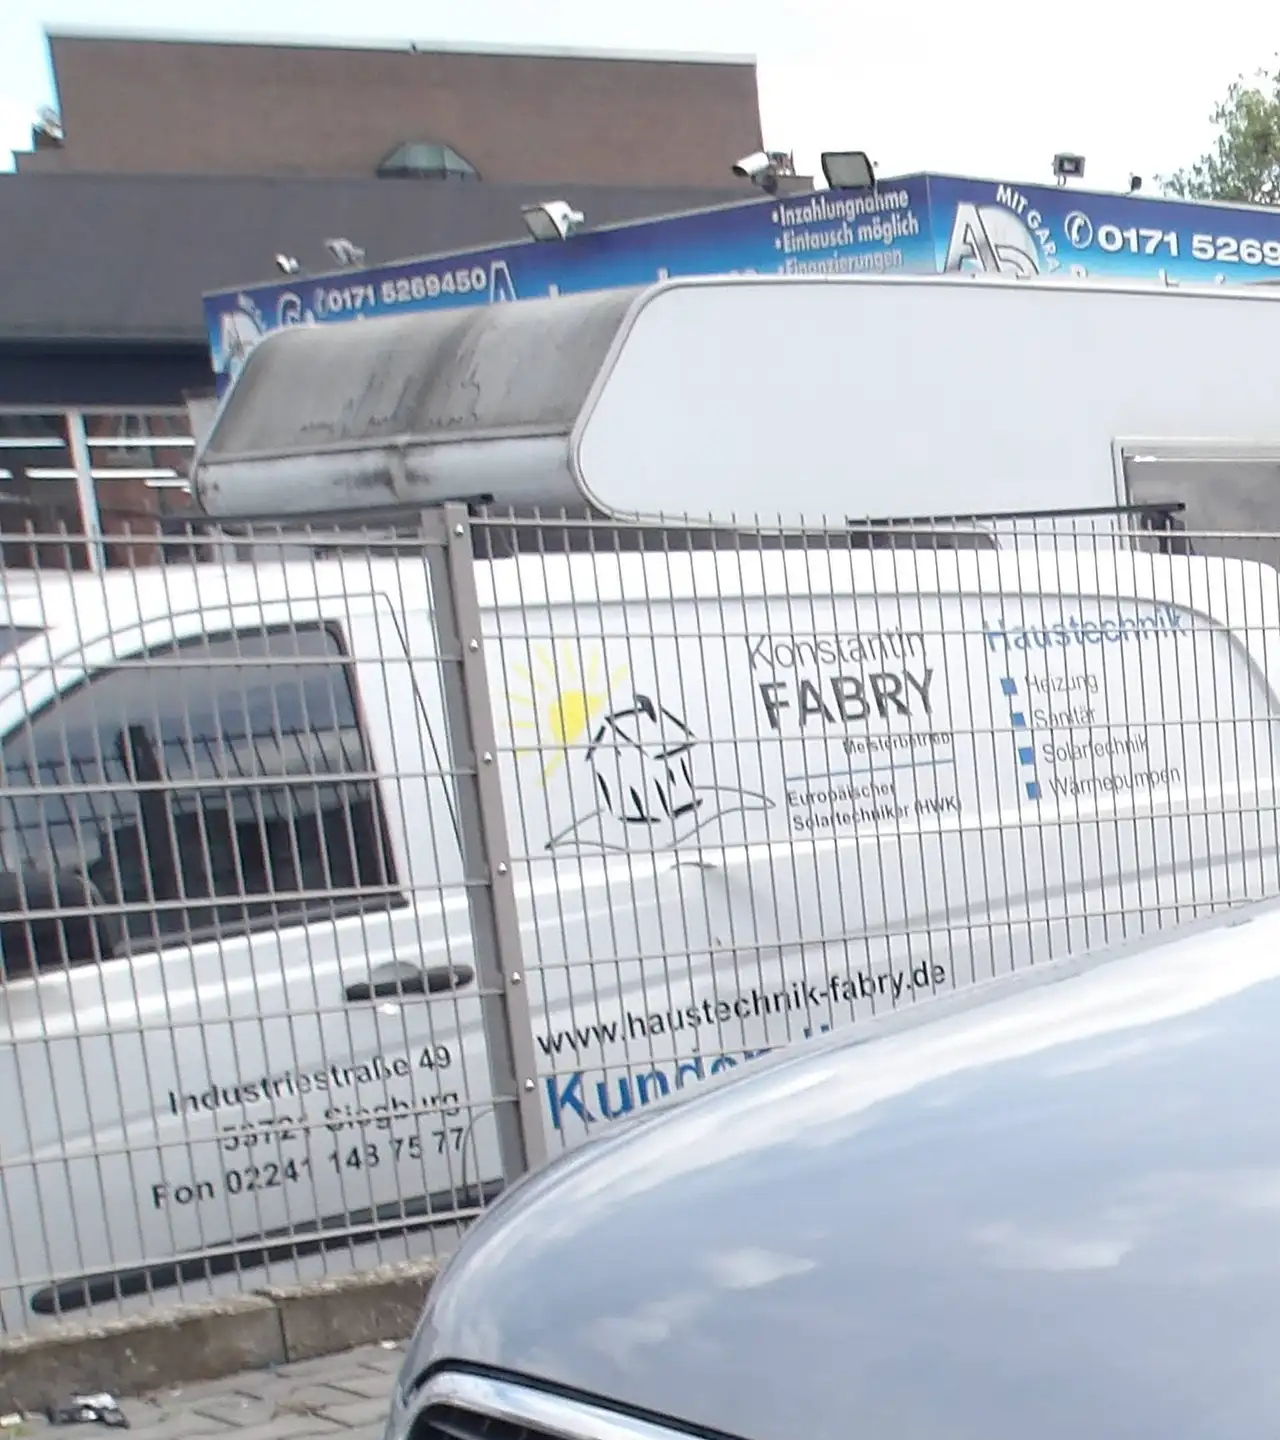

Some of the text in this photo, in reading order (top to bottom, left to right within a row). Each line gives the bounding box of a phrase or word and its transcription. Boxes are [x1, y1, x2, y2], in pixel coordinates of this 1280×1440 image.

[779, 188, 910, 226] Inzahlungnahme
[996, 184, 1028, 214] MIT
[782, 221, 854, 253] Eintausch
[857, 210, 920, 245] möglich
[1098, 224, 1178, 257] 0171
[785, 249, 904, 275] Finanzierungen
[328, 284, 375, 312] 0171
[984, 604, 1189, 652] Haustechnik
[746, 626, 924, 670] Konstantin
[759, 668, 934, 730] FABRY
[1025, 672, 1099, 694] Heizung
[1034, 705, 1096, 728] Sanitär
[1042, 733, 1149, 764] Solartechnik
[788, 781, 896, 807] Europäischer
[1049, 765, 1182, 797] Wärmepumpen
[793, 803, 910, 831] Solartechniker
[537, 960, 946, 1055] www.haustechnik-fabry.de
[168, 1044, 451, 1115] Industriestraße 49
[151, 1179, 214, 1209] Fon
[226, 1157, 312, 1195] 02241
[389, 1134, 421, 1163] 75
[432, 1127, 464, 1154] 77
